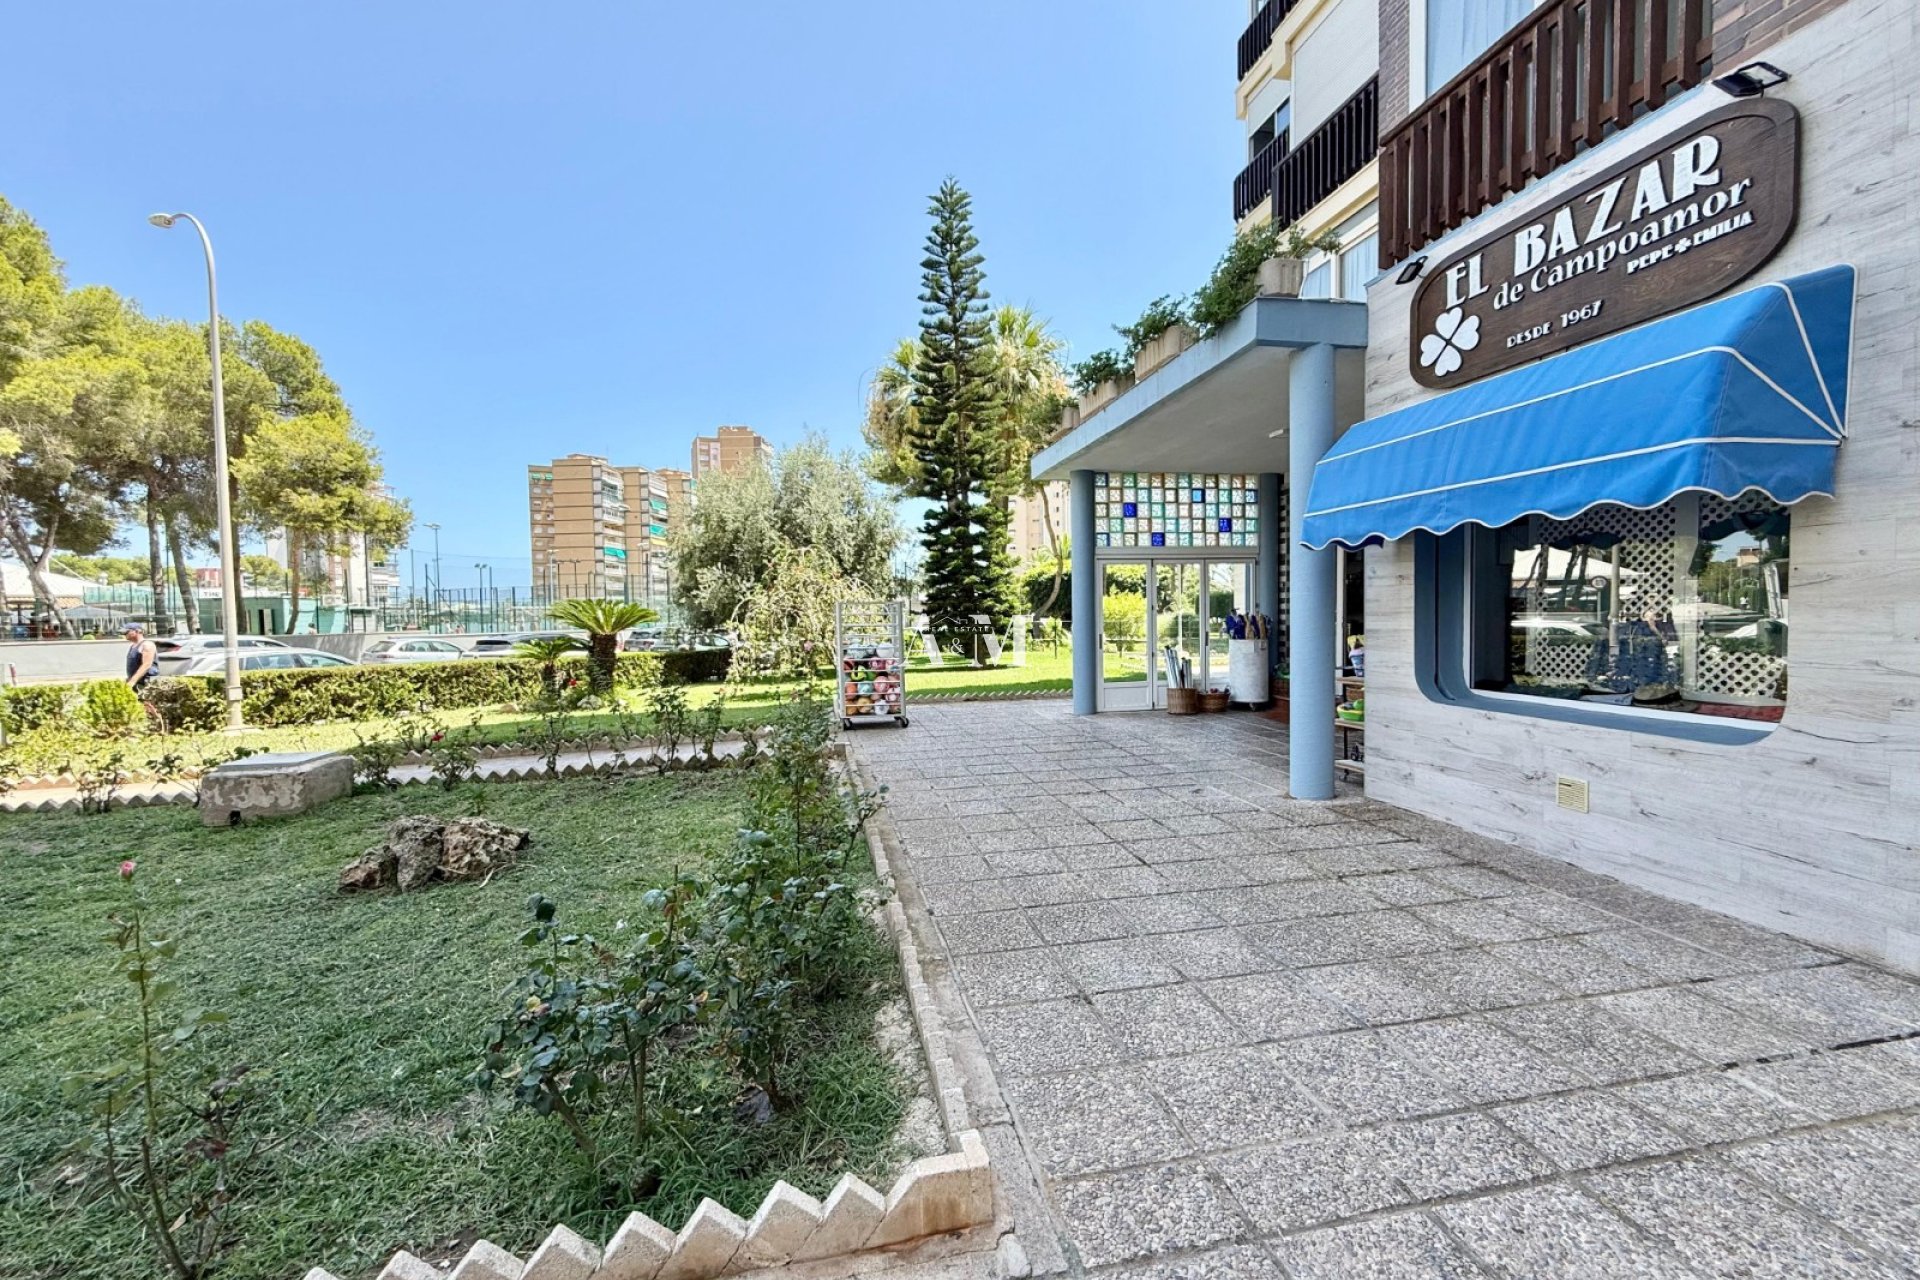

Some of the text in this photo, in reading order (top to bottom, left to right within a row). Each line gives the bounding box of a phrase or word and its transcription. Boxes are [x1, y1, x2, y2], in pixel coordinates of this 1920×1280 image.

[1446, 135, 1720, 309] EL BAZAR
[1493, 178, 1751, 310] de Campoamor
[1627, 211, 1753, 274] PEPE EMILIA
[1507, 300, 1603, 348] DESDE 1967
